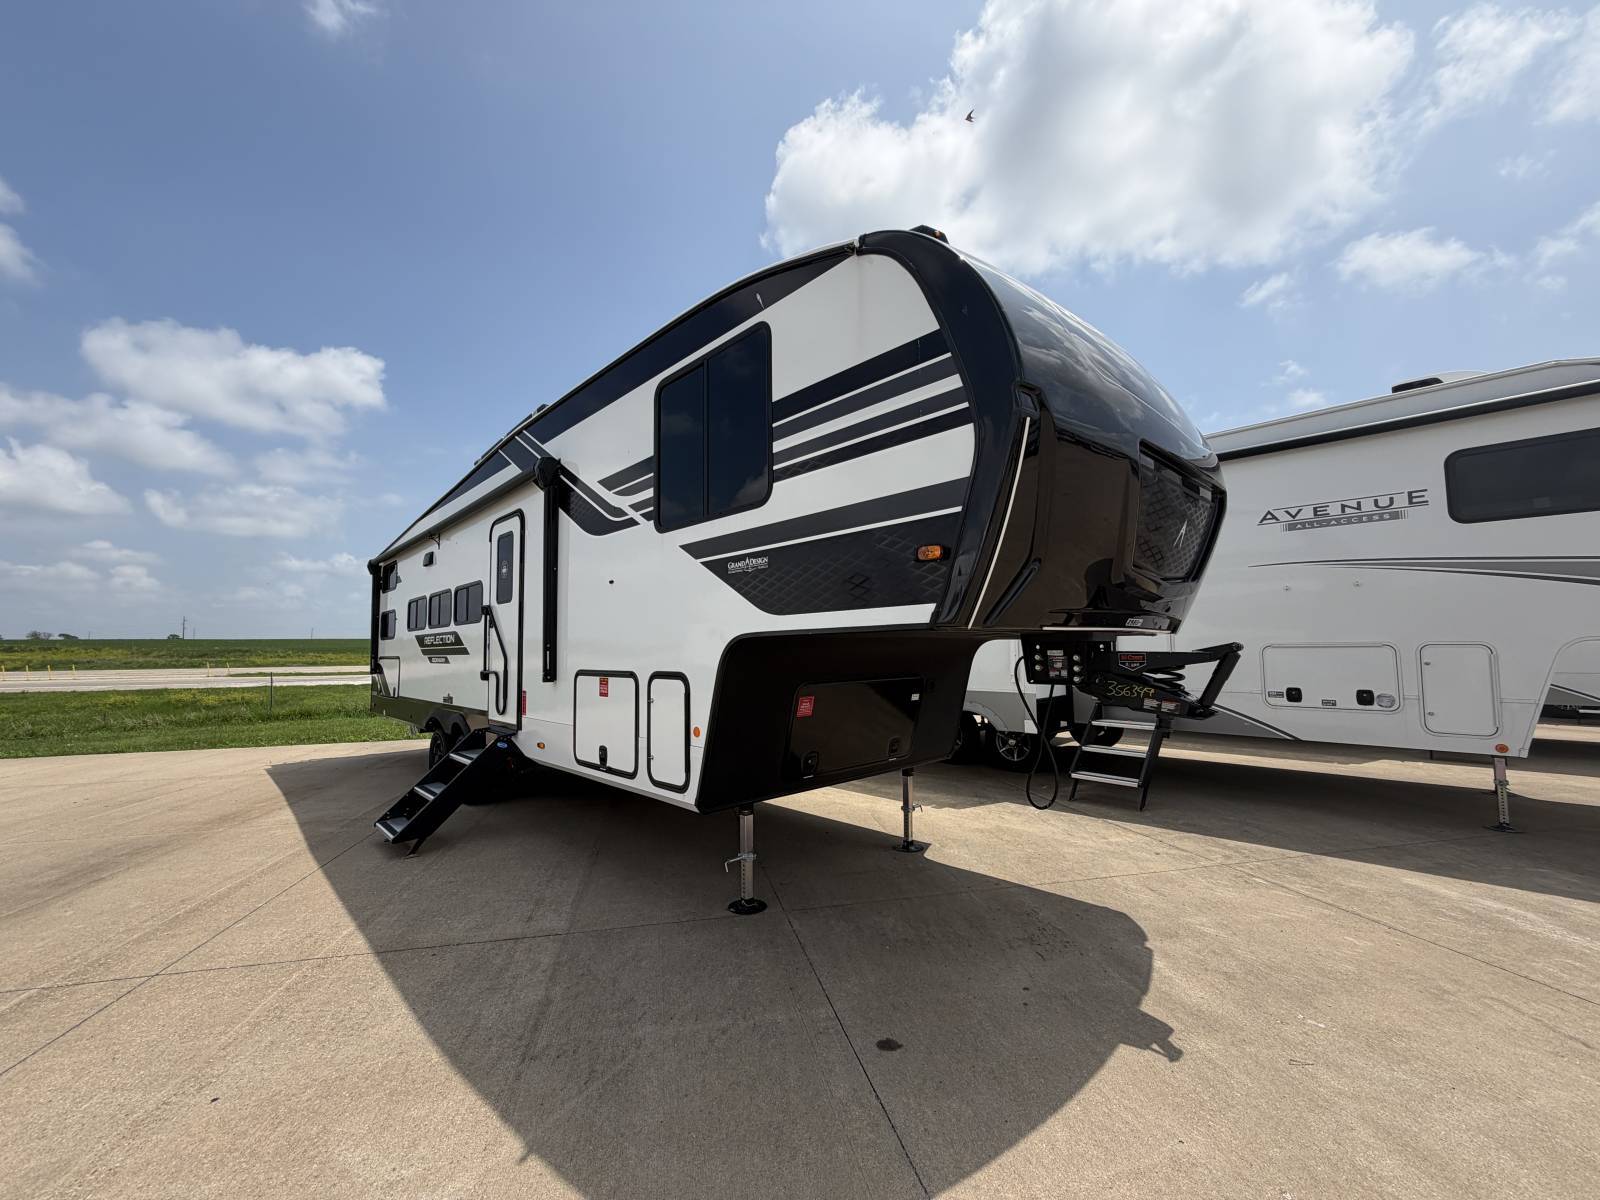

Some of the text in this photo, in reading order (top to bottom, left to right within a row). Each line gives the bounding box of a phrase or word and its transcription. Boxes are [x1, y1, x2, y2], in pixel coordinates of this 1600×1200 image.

[1259, 488, 1428, 523] AVENUE
[1295, 512, 1391, 529] ALL-ACCESS
[424, 634, 455, 645] REFLECTION
